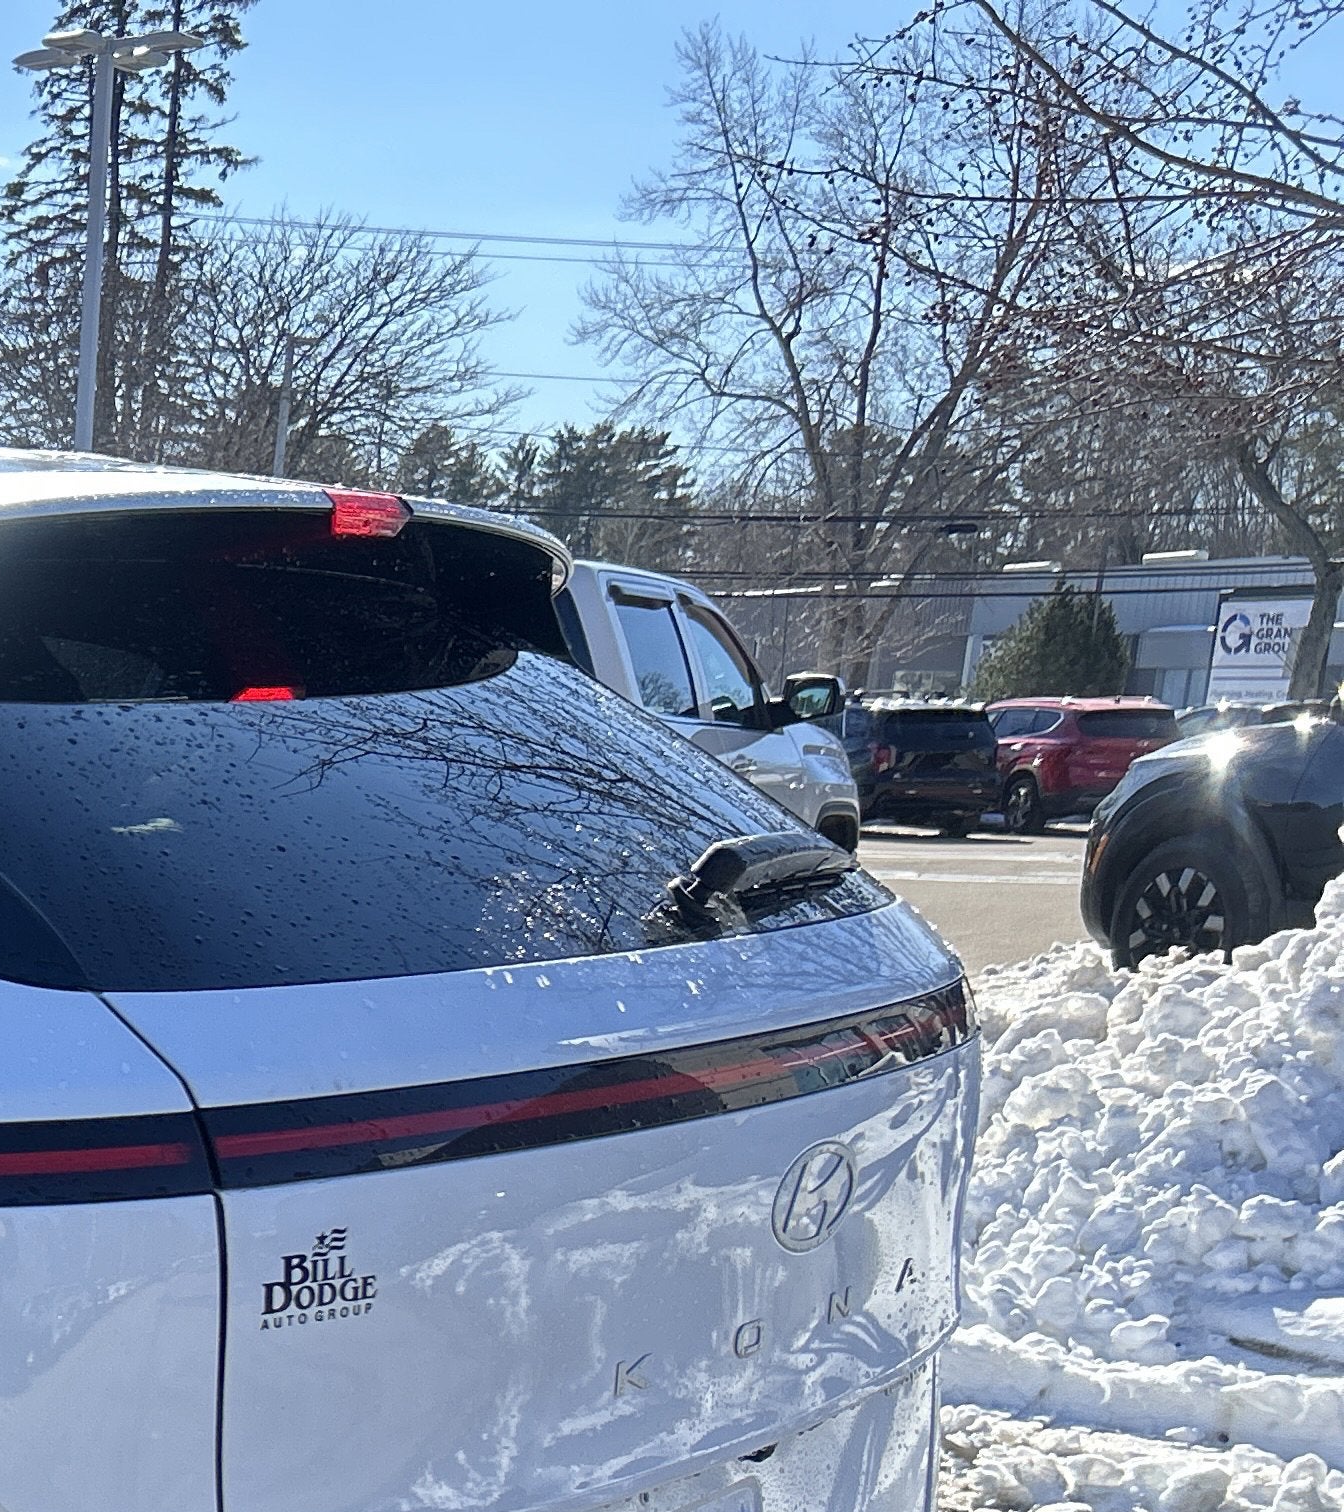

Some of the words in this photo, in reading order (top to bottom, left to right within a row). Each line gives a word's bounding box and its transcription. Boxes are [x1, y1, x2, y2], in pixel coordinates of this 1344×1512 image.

[1255, 627, 1293, 641] GRAN
[1259, 612, 1284, 627] THE
[1253, 641, 1289, 655] GROU
[280, 1253, 355, 1287] BILL
[260, 1274, 379, 1316] DODGE
[259, 1314, 308, 1331] AUTO
[314, 1302, 374, 1322] GROUP
[613, 1256, 918, 1397] KONA
